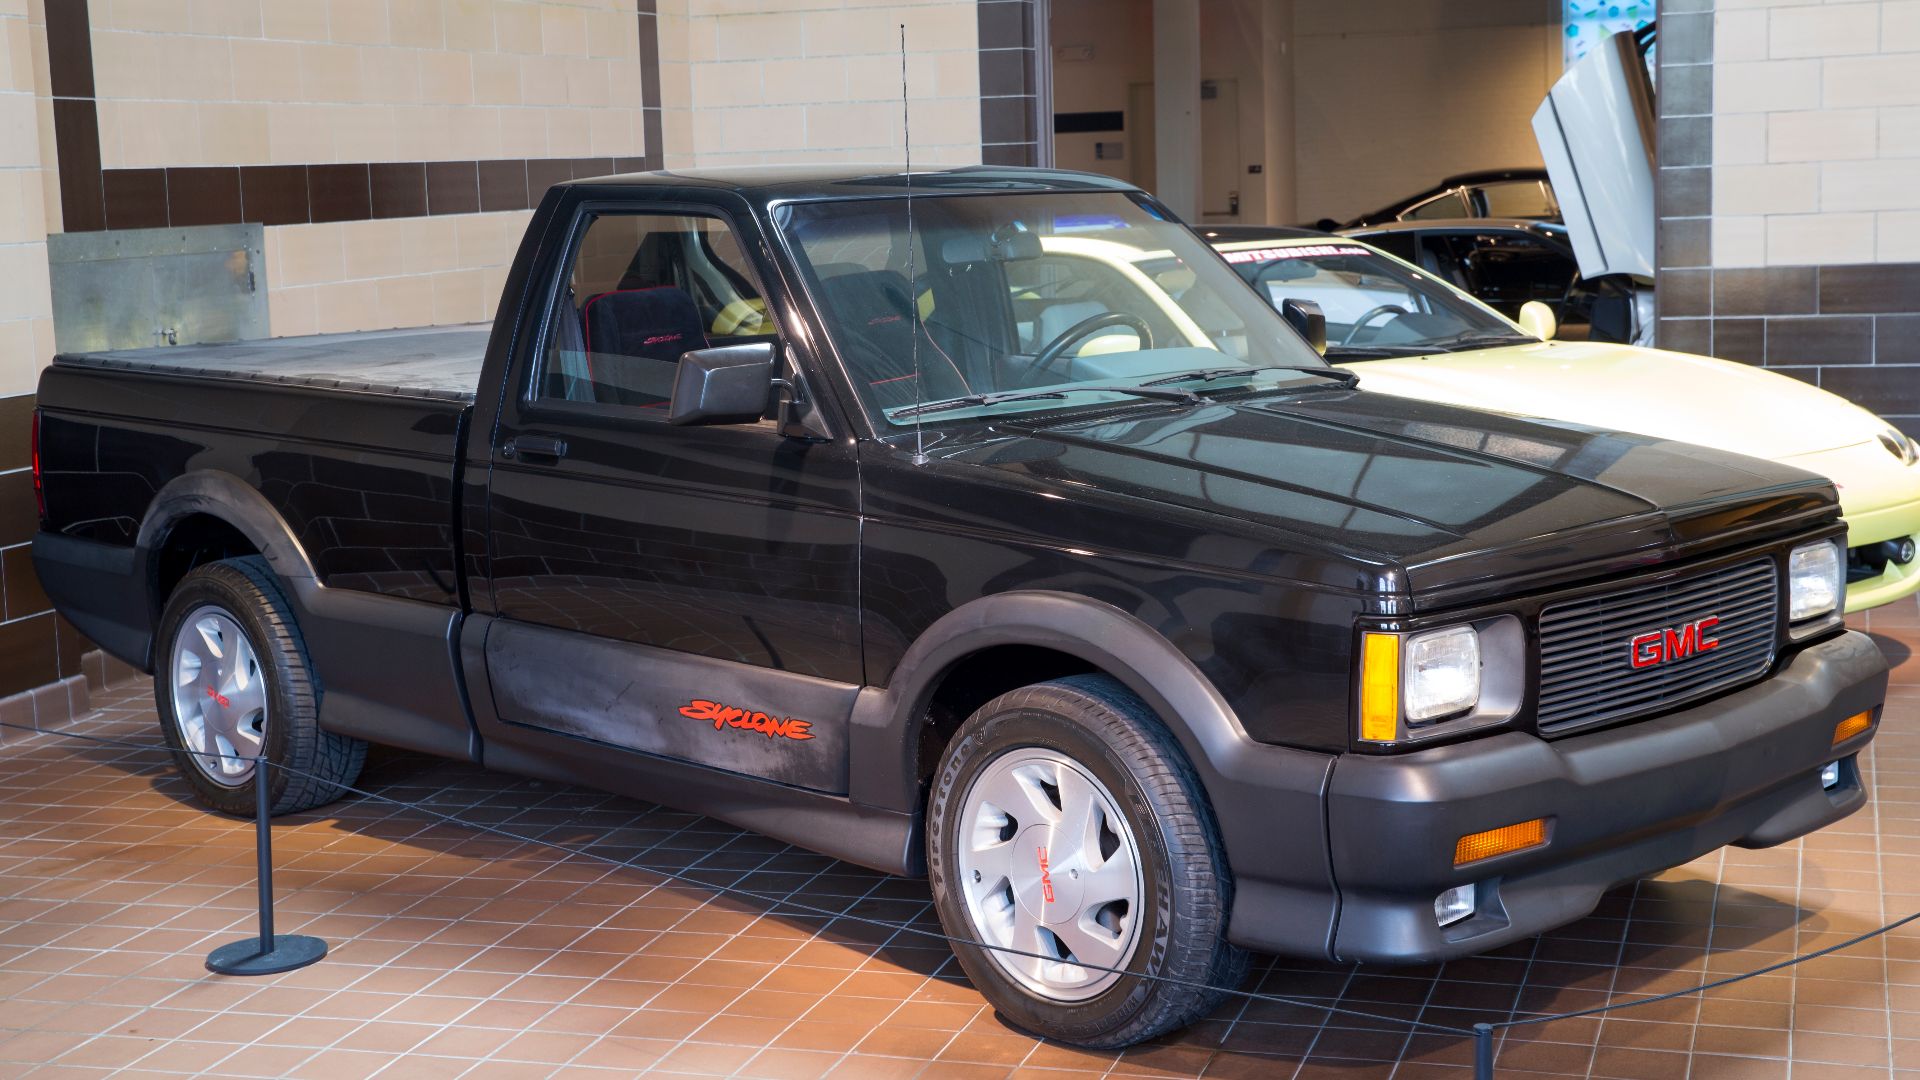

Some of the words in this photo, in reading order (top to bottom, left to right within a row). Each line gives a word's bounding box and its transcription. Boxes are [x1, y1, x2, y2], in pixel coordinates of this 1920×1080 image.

[1630, 615, 1720, 669] GMC
[679, 699, 817, 740] SYCLONE
[1037, 846, 1055, 903] GMC
